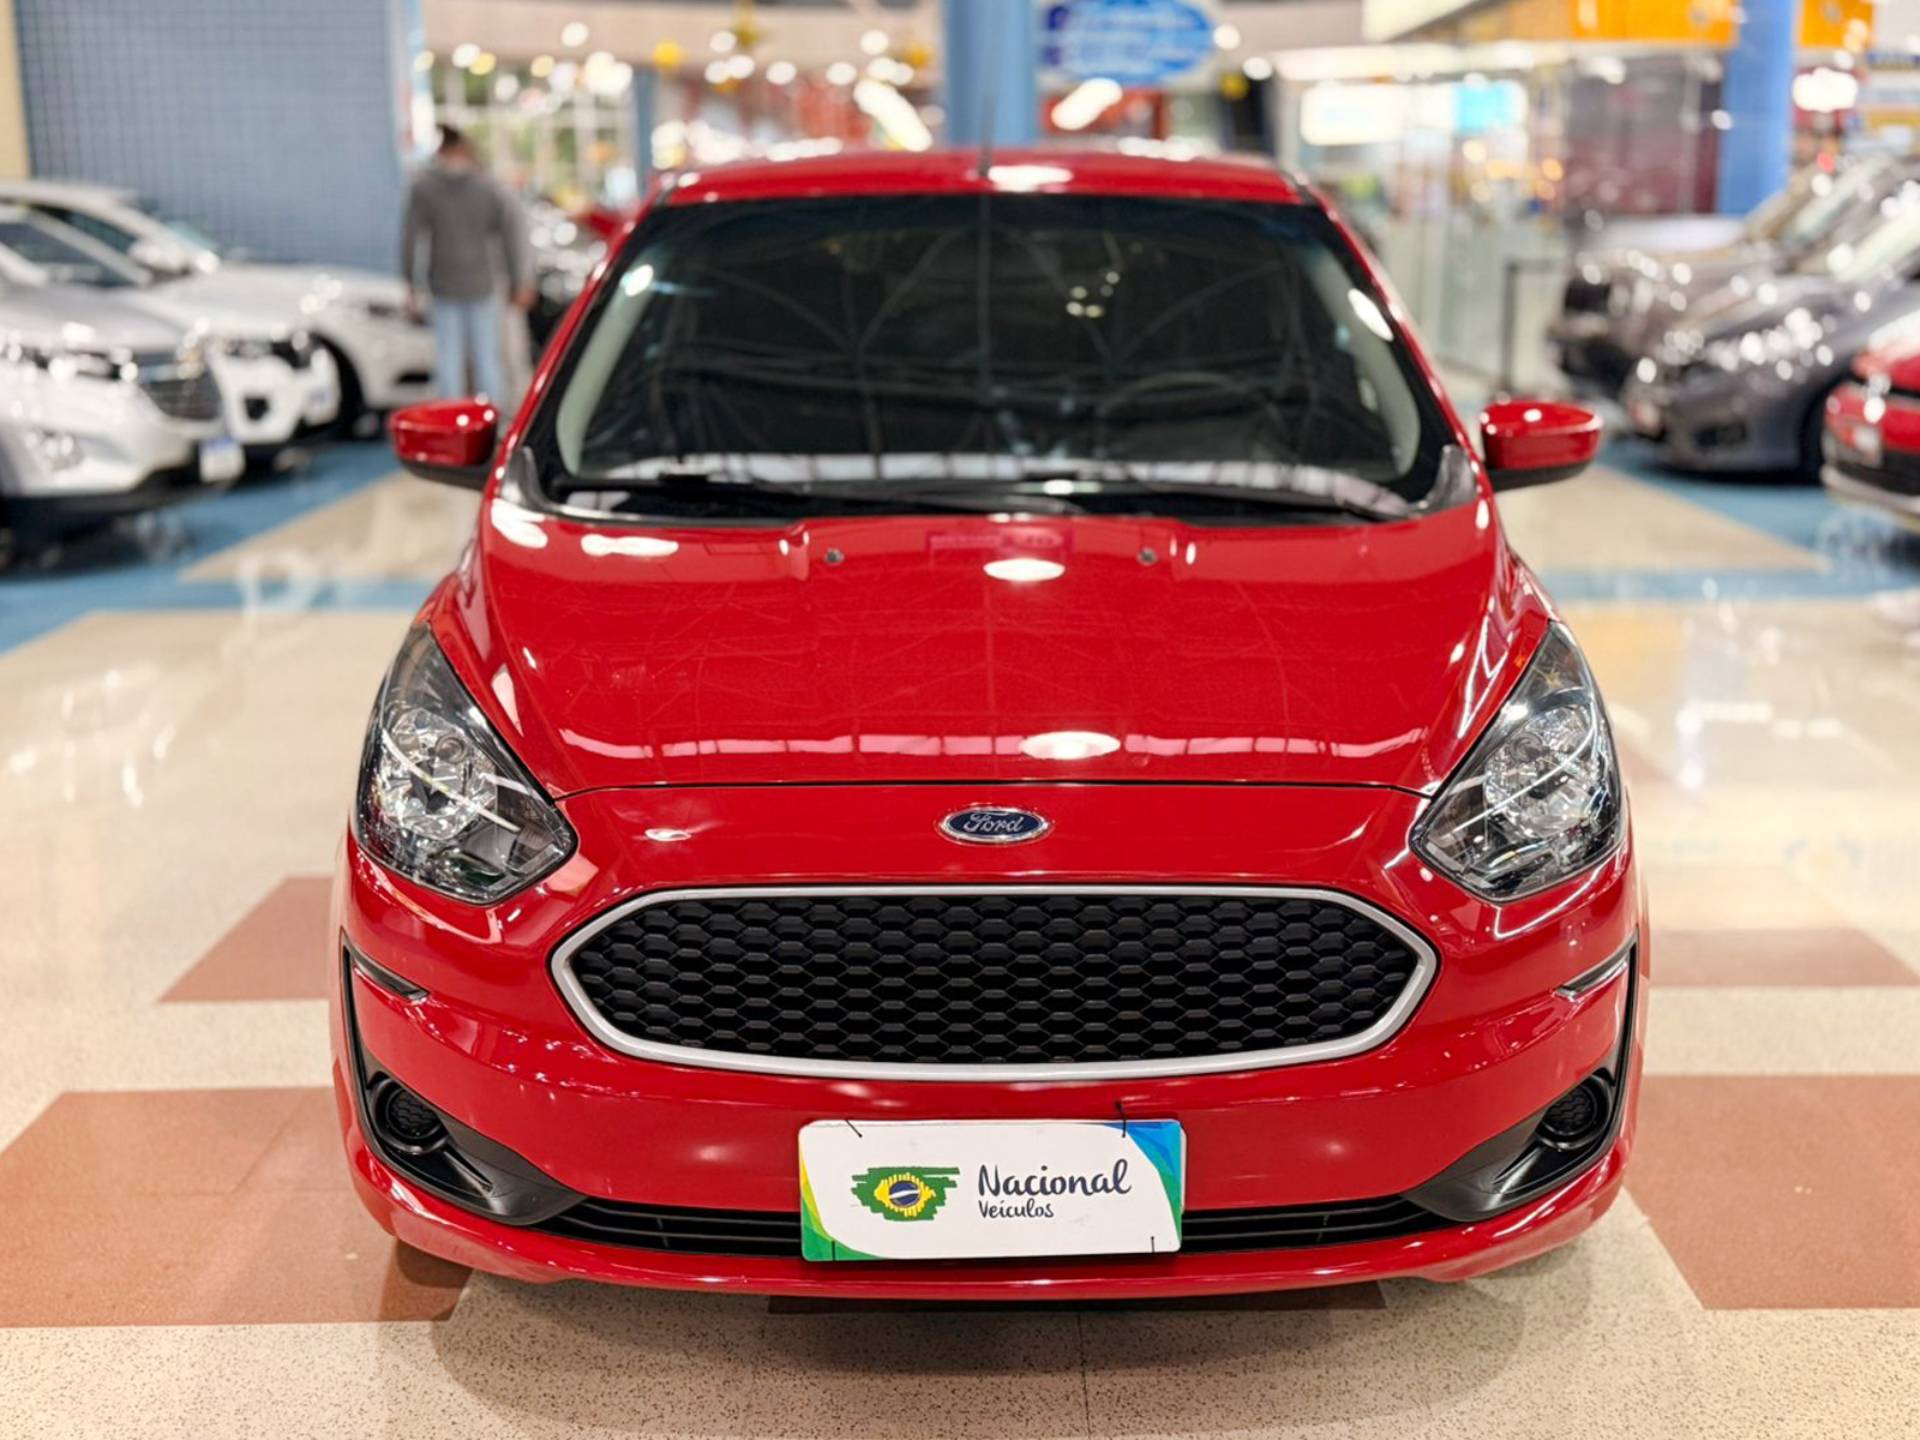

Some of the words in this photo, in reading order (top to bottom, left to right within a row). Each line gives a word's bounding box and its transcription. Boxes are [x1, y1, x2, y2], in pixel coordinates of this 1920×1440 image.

[963, 812, 1025, 832] Ford
[978, 1158, 1132, 1197] Nacional
[978, 1198, 1054, 1218] Veículos
